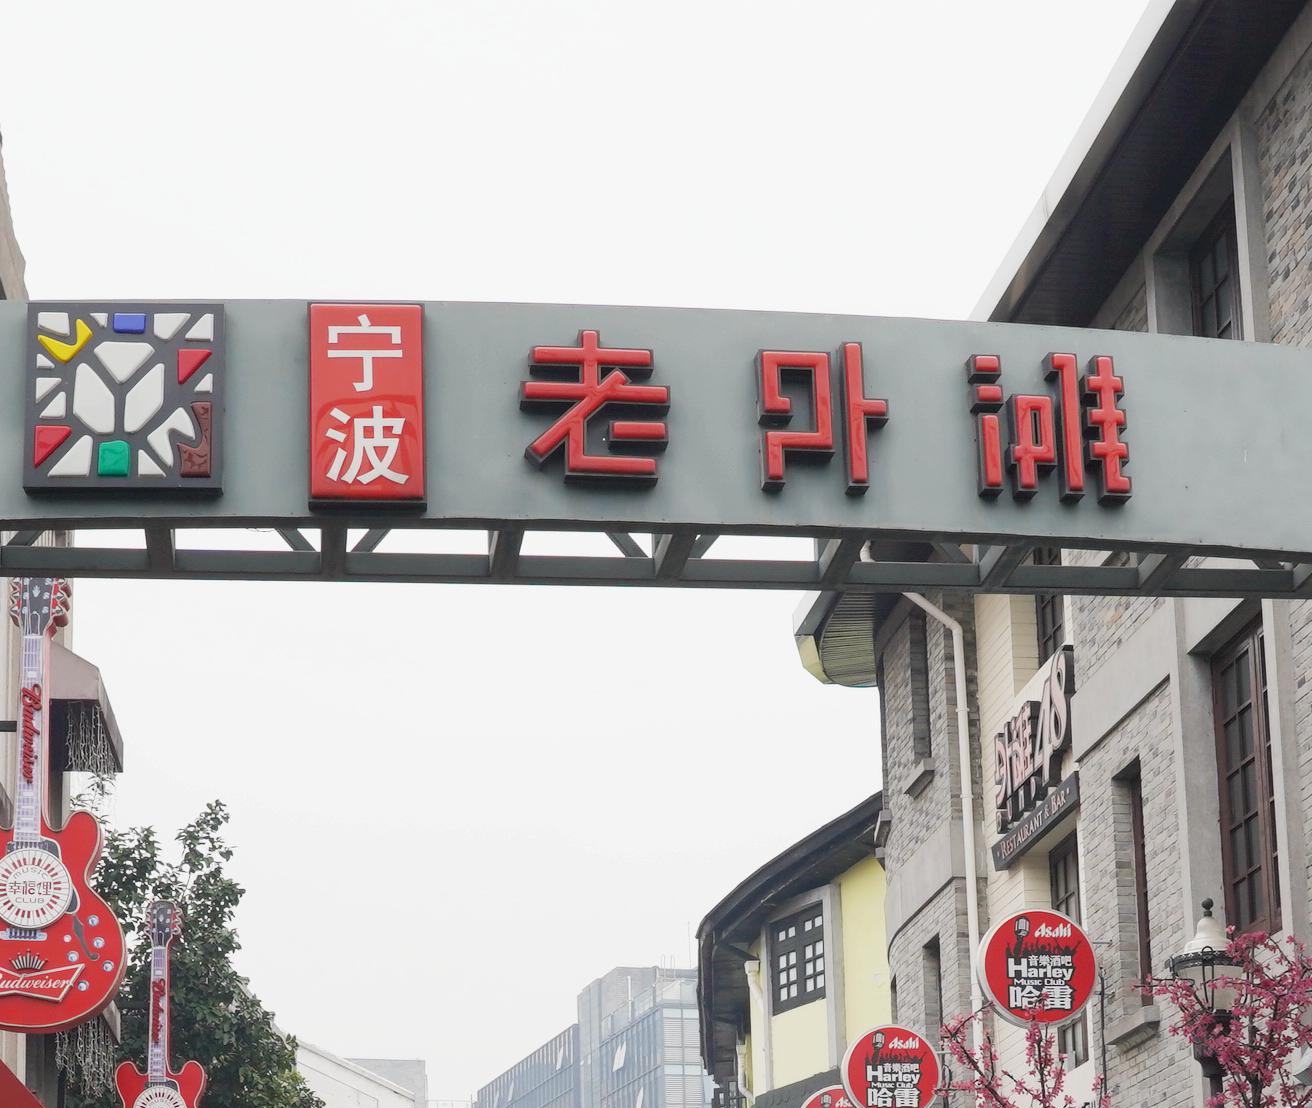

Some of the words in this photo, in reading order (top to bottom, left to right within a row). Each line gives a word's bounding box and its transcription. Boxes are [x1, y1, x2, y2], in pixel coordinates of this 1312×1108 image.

[326, 314, 409, 485] 宁波
[520, 328, 1133, 507] 老外滩
[21, 683, 42, 784] Budweiser
[1035, 923, 1072, 938] Asahi
[1008, 957, 1074, 980] Harley
[1009, 986, 1073, 1010] 哈雷
[889, 1037, 919, 1049] Asahi
[867, 1065, 920, 1084] Harley
[868, 1088, 920, 1108] 哈雷
